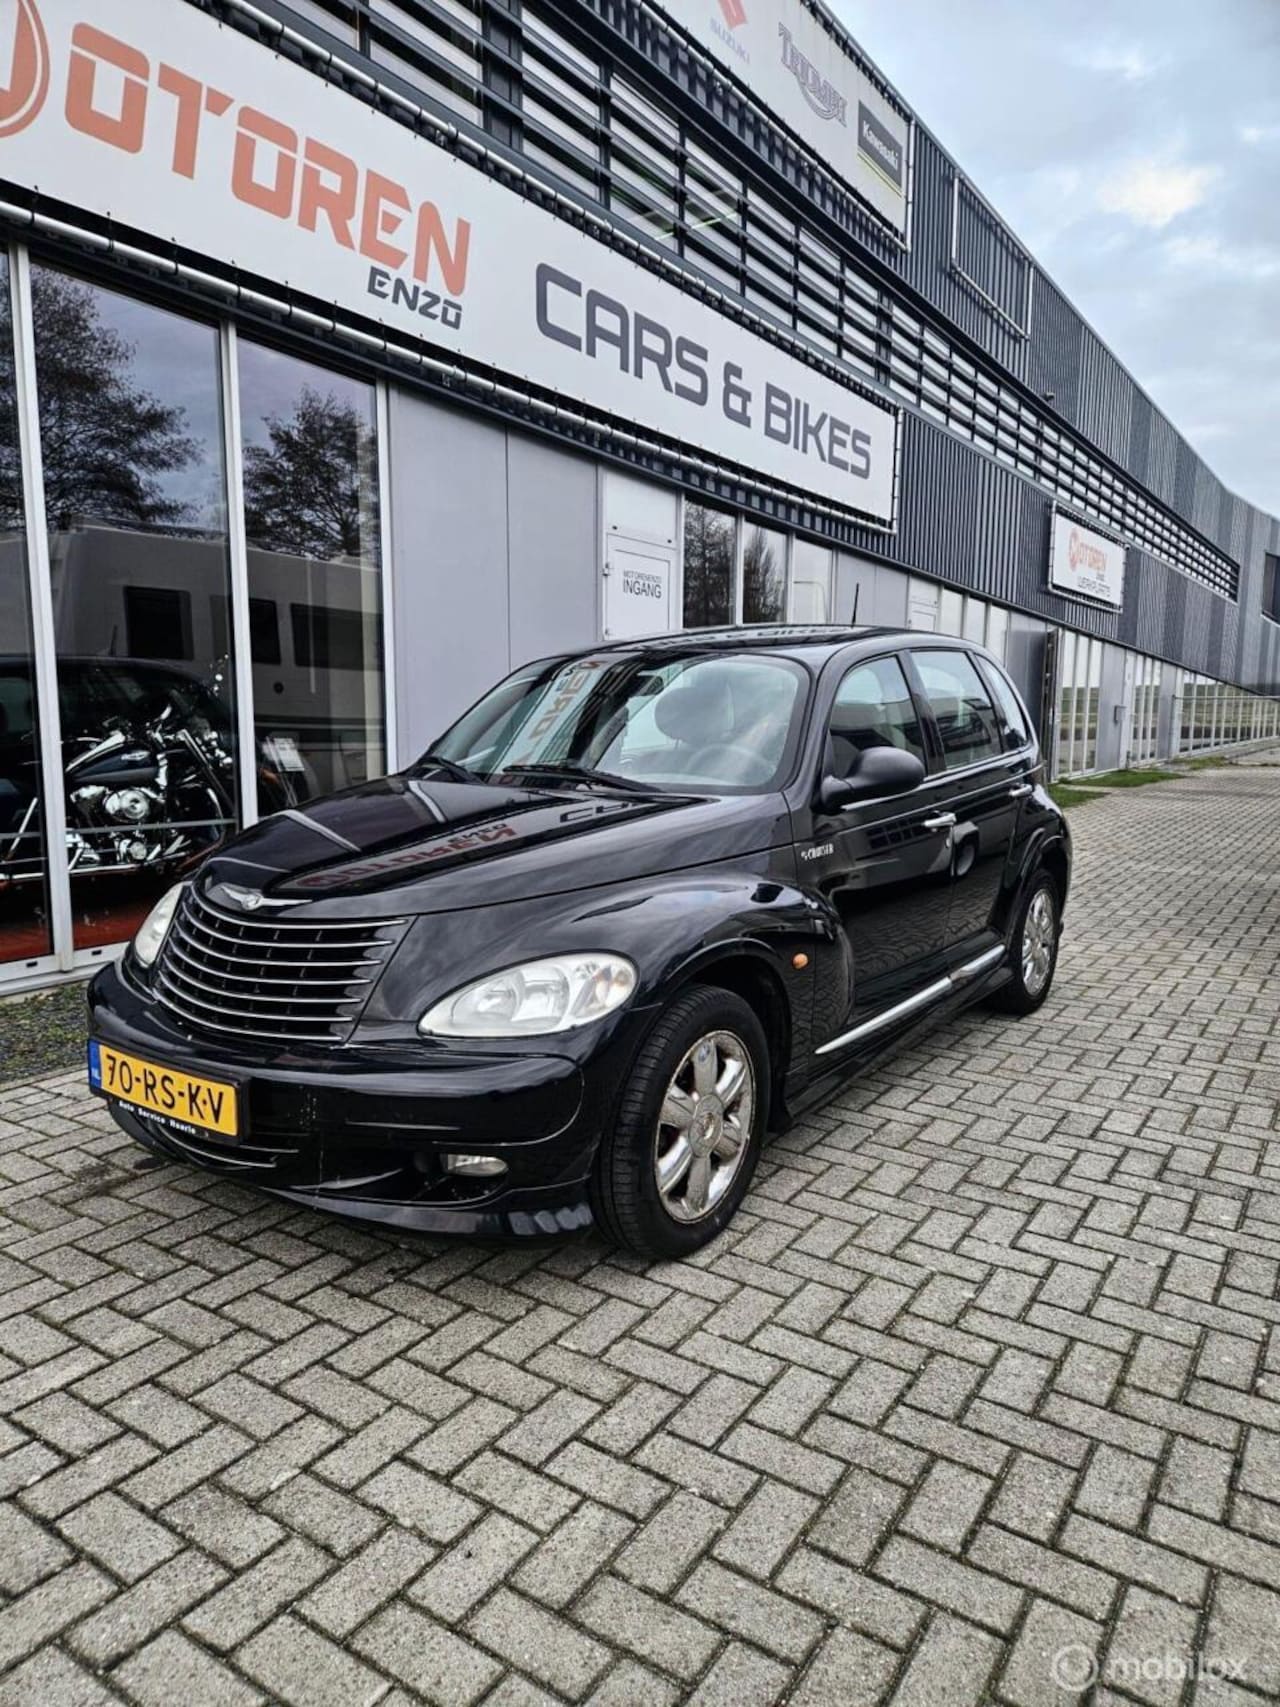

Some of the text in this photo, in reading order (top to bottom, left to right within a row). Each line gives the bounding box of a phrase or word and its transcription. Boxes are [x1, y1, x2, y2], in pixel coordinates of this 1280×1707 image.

[367, 264, 462, 330] ENZO
[535, 262, 873, 481] CARS & BIKES
[623, 579, 662, 599] INGANG
